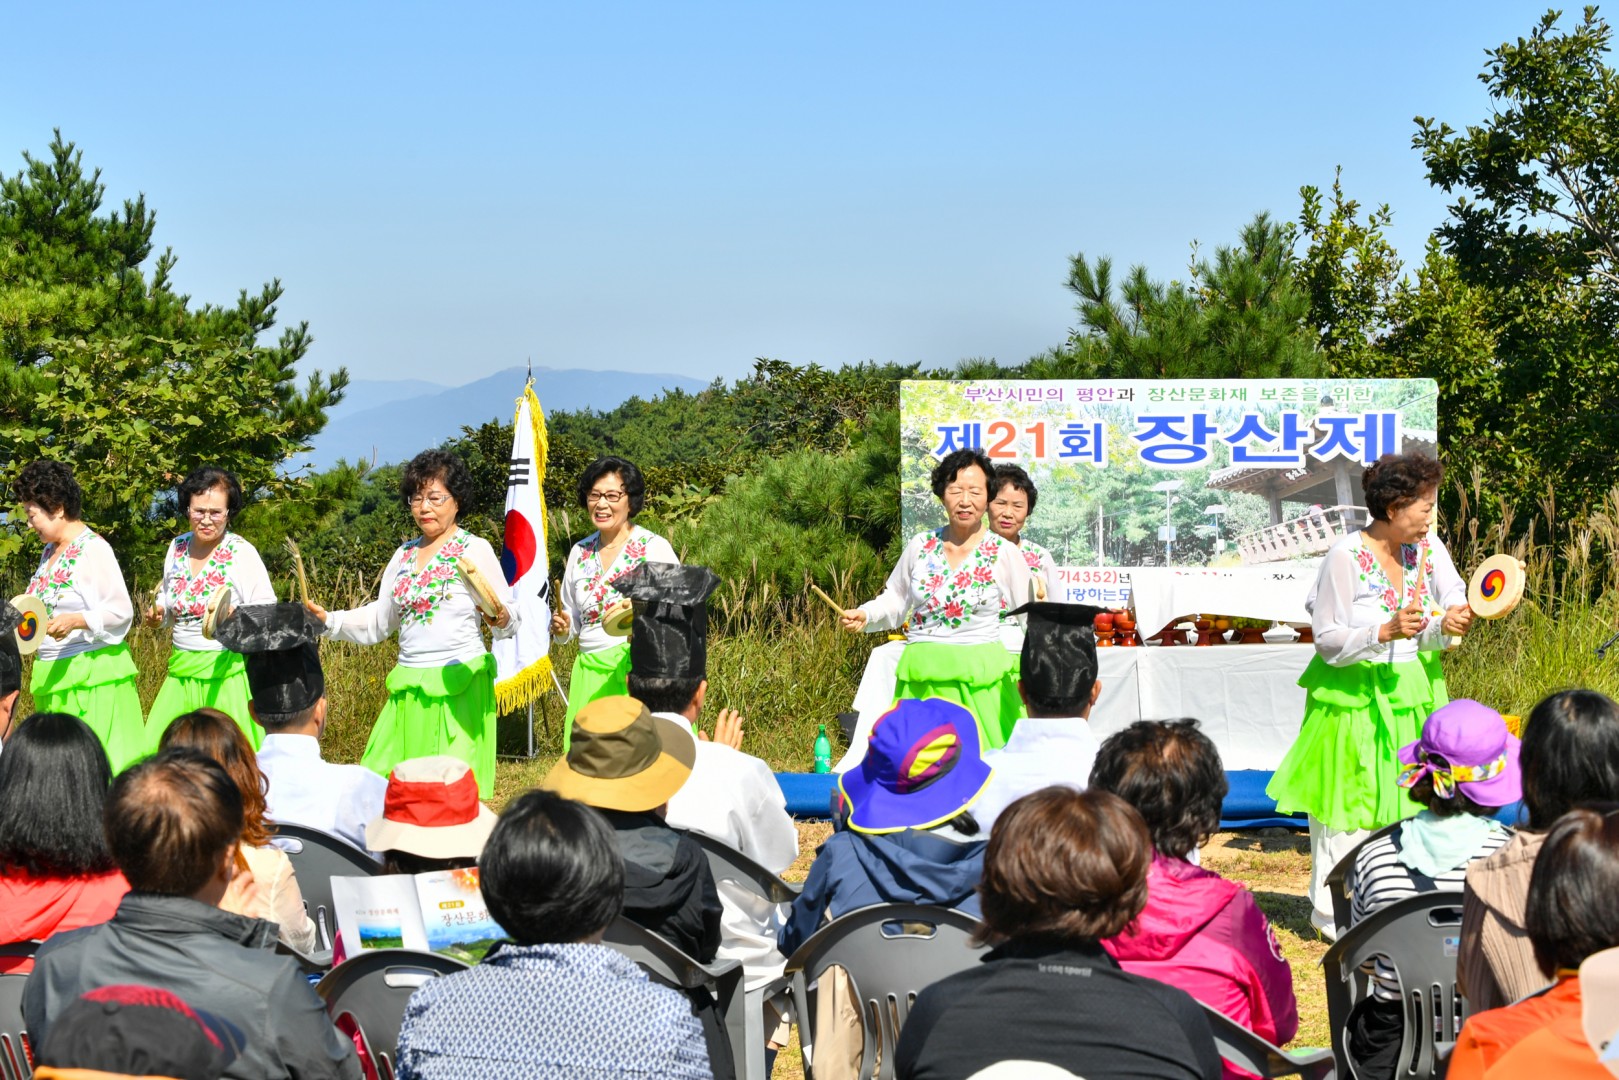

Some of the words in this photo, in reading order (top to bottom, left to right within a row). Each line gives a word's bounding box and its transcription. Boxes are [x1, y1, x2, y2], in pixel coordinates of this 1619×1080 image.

[965, 388, 1063, 402] 부산시민의
[1076, 388, 1135, 402] 평안과
[1148, 387, 1247, 401] 장산문화재
[1260, 387, 1319, 401] 보존을
[1333, 387, 1373, 401] 위한
[935, 421, 1102, 463] 제21회
[1134, 413, 1396, 464] 장산제
